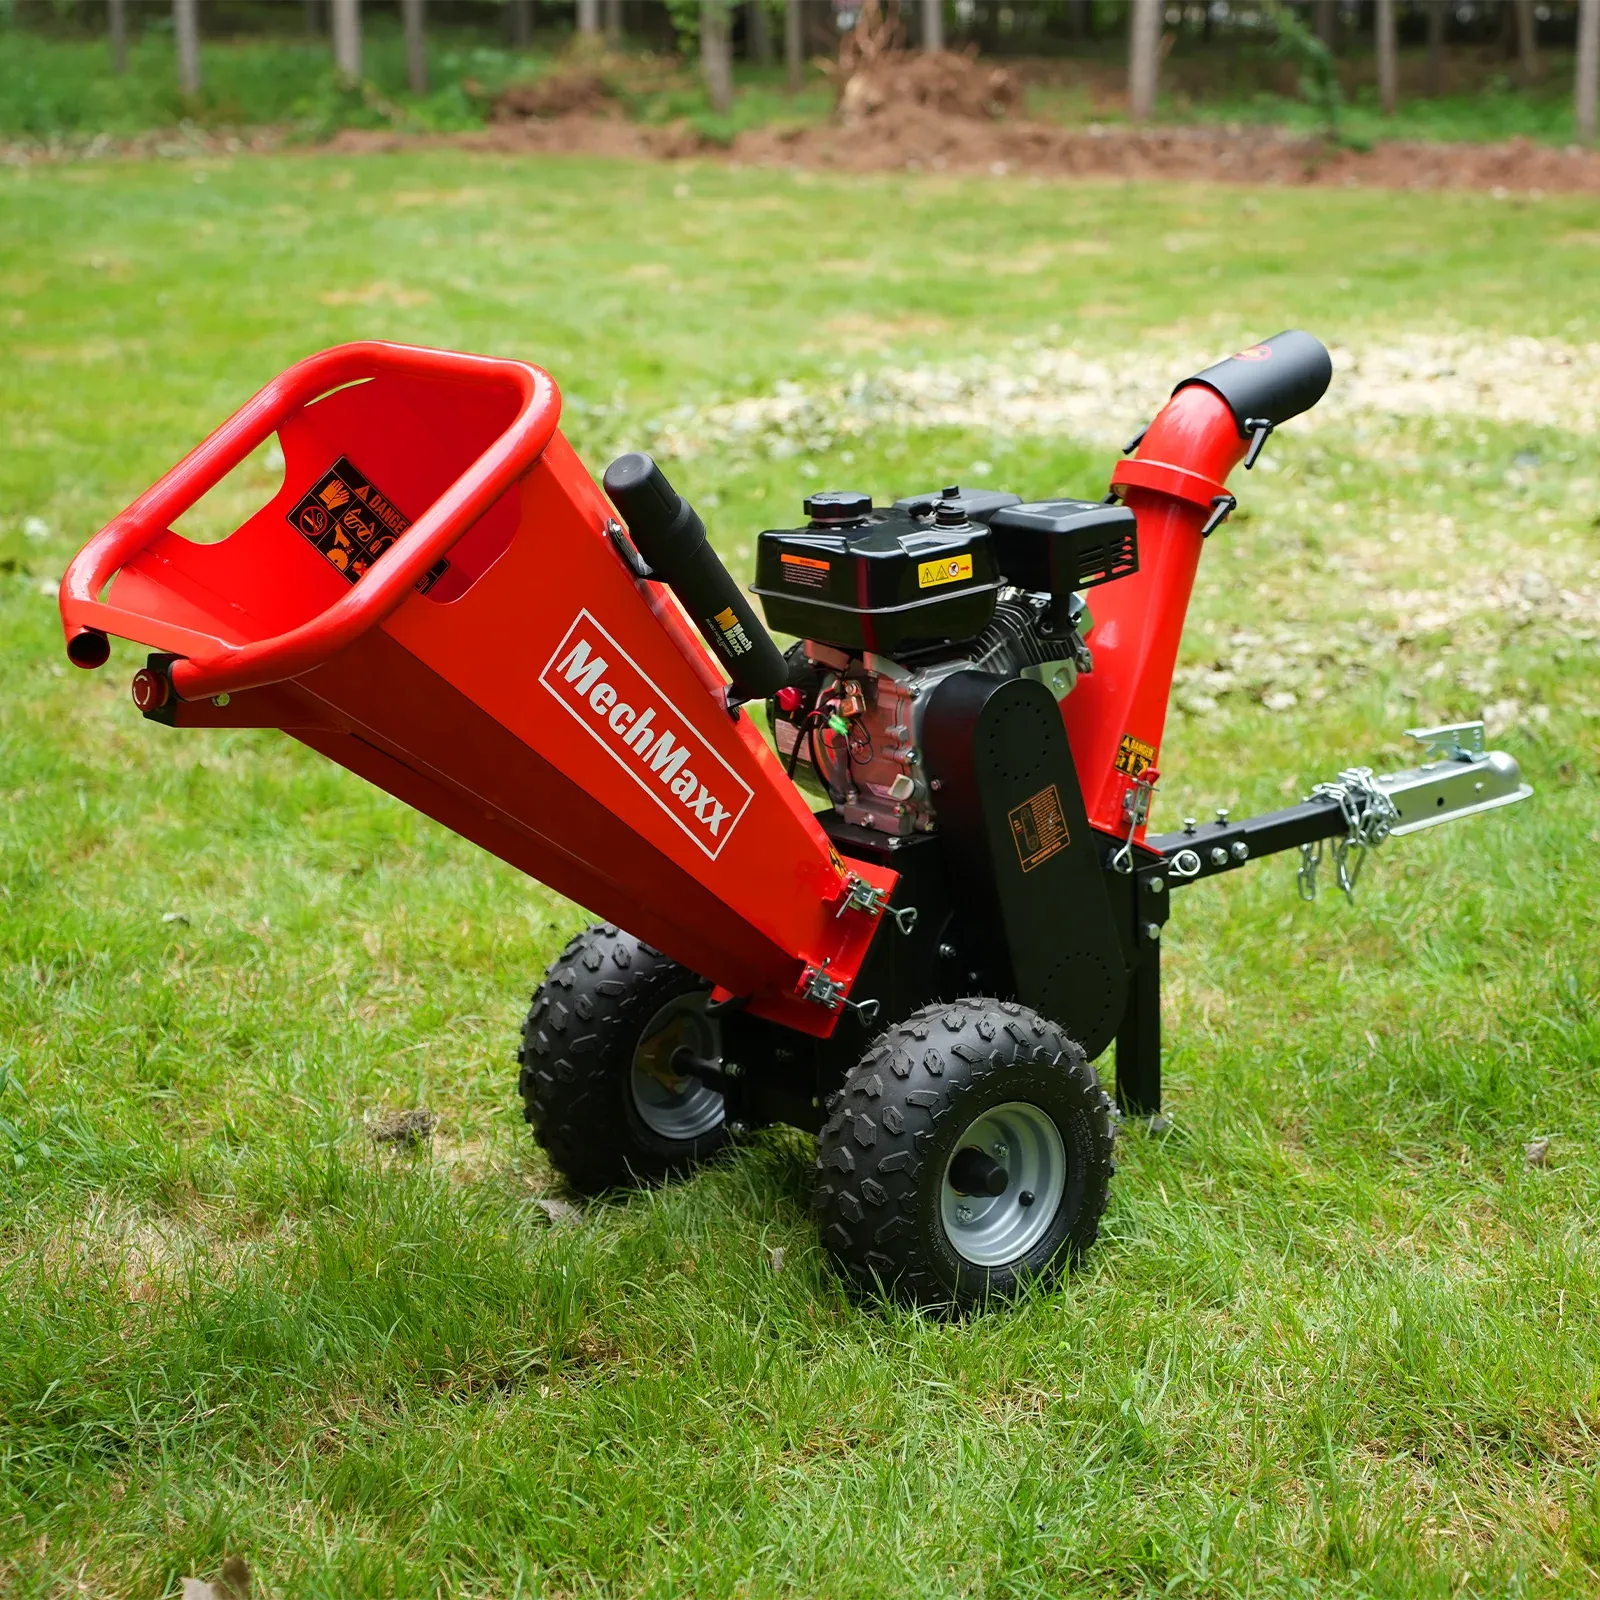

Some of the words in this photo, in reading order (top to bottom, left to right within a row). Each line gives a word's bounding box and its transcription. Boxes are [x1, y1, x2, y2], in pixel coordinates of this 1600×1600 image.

[723, 629, 745, 656] Maxx
[732, 623, 753, 651] Mech
[555, 638, 732, 837] MechMaxx
